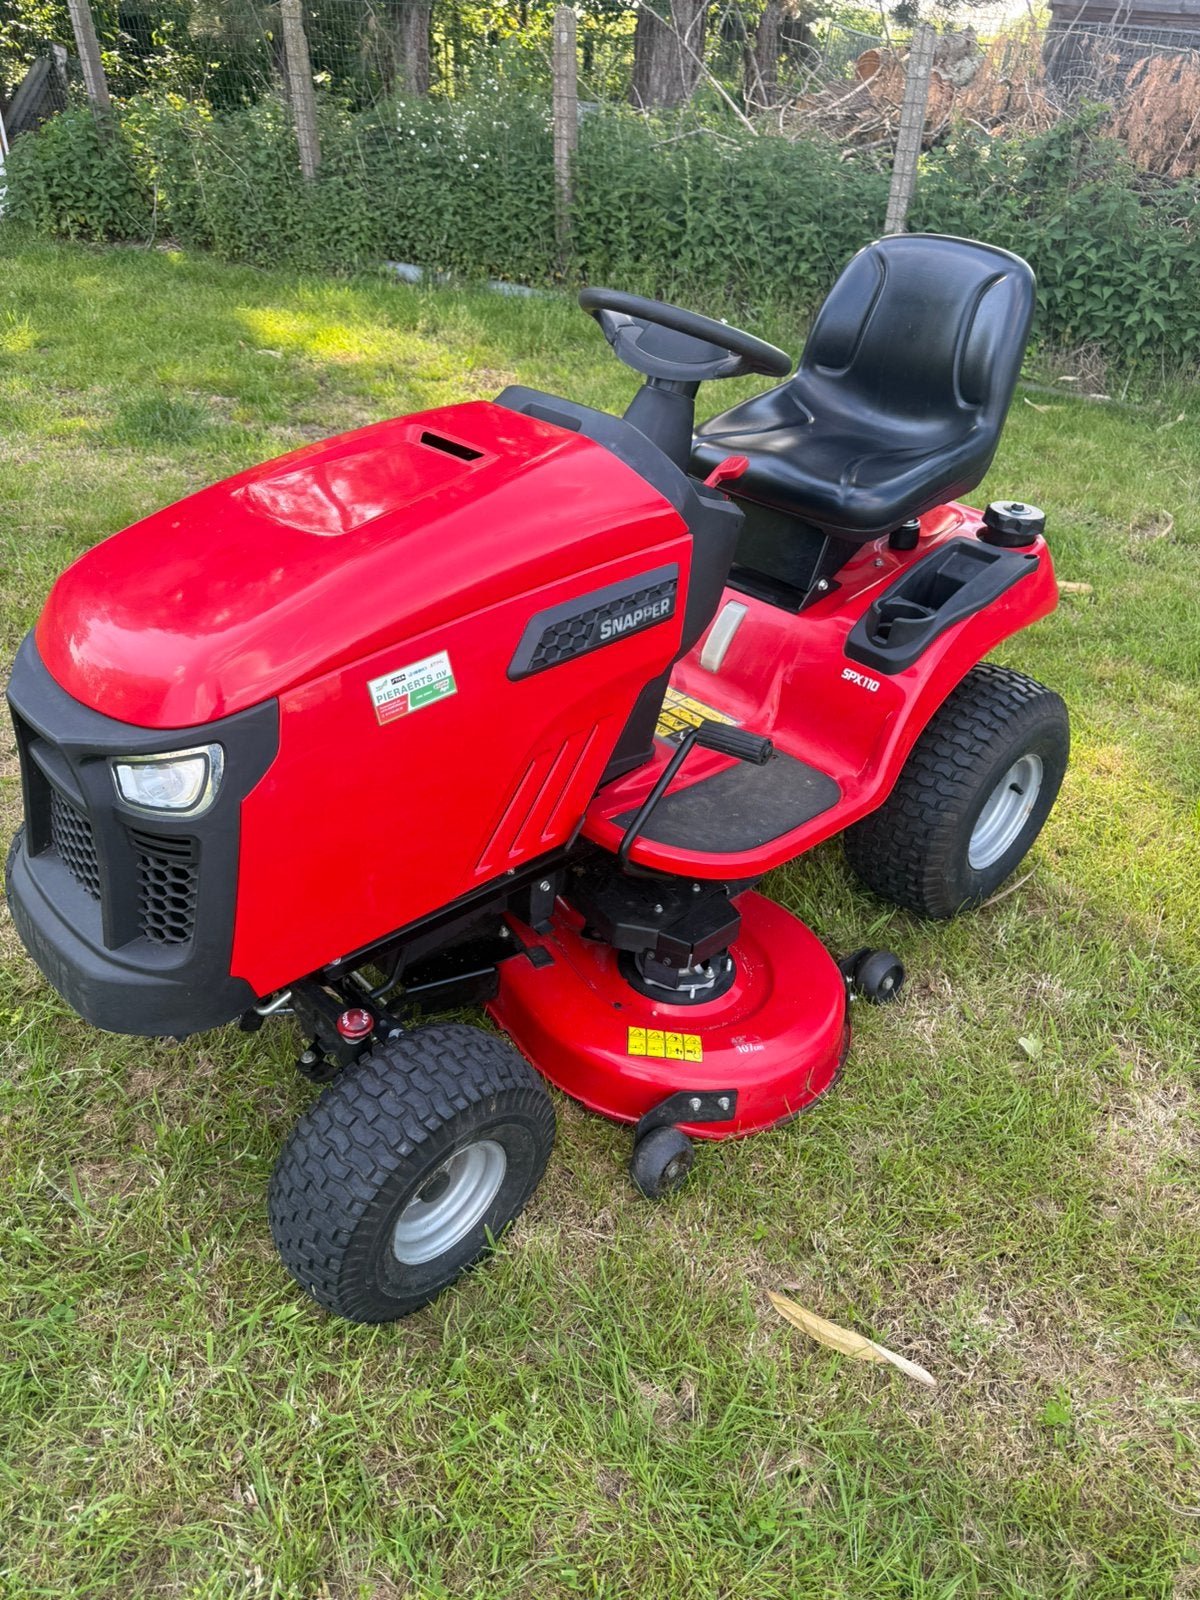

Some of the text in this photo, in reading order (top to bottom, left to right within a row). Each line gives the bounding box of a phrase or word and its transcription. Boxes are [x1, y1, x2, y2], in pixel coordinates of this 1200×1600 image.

[600, 597, 670, 640] SNAPPER
[376, 674, 433, 704] PIERAERTS
[435, 669, 447, 680] nv
[841, 667, 881, 693] SPX110
